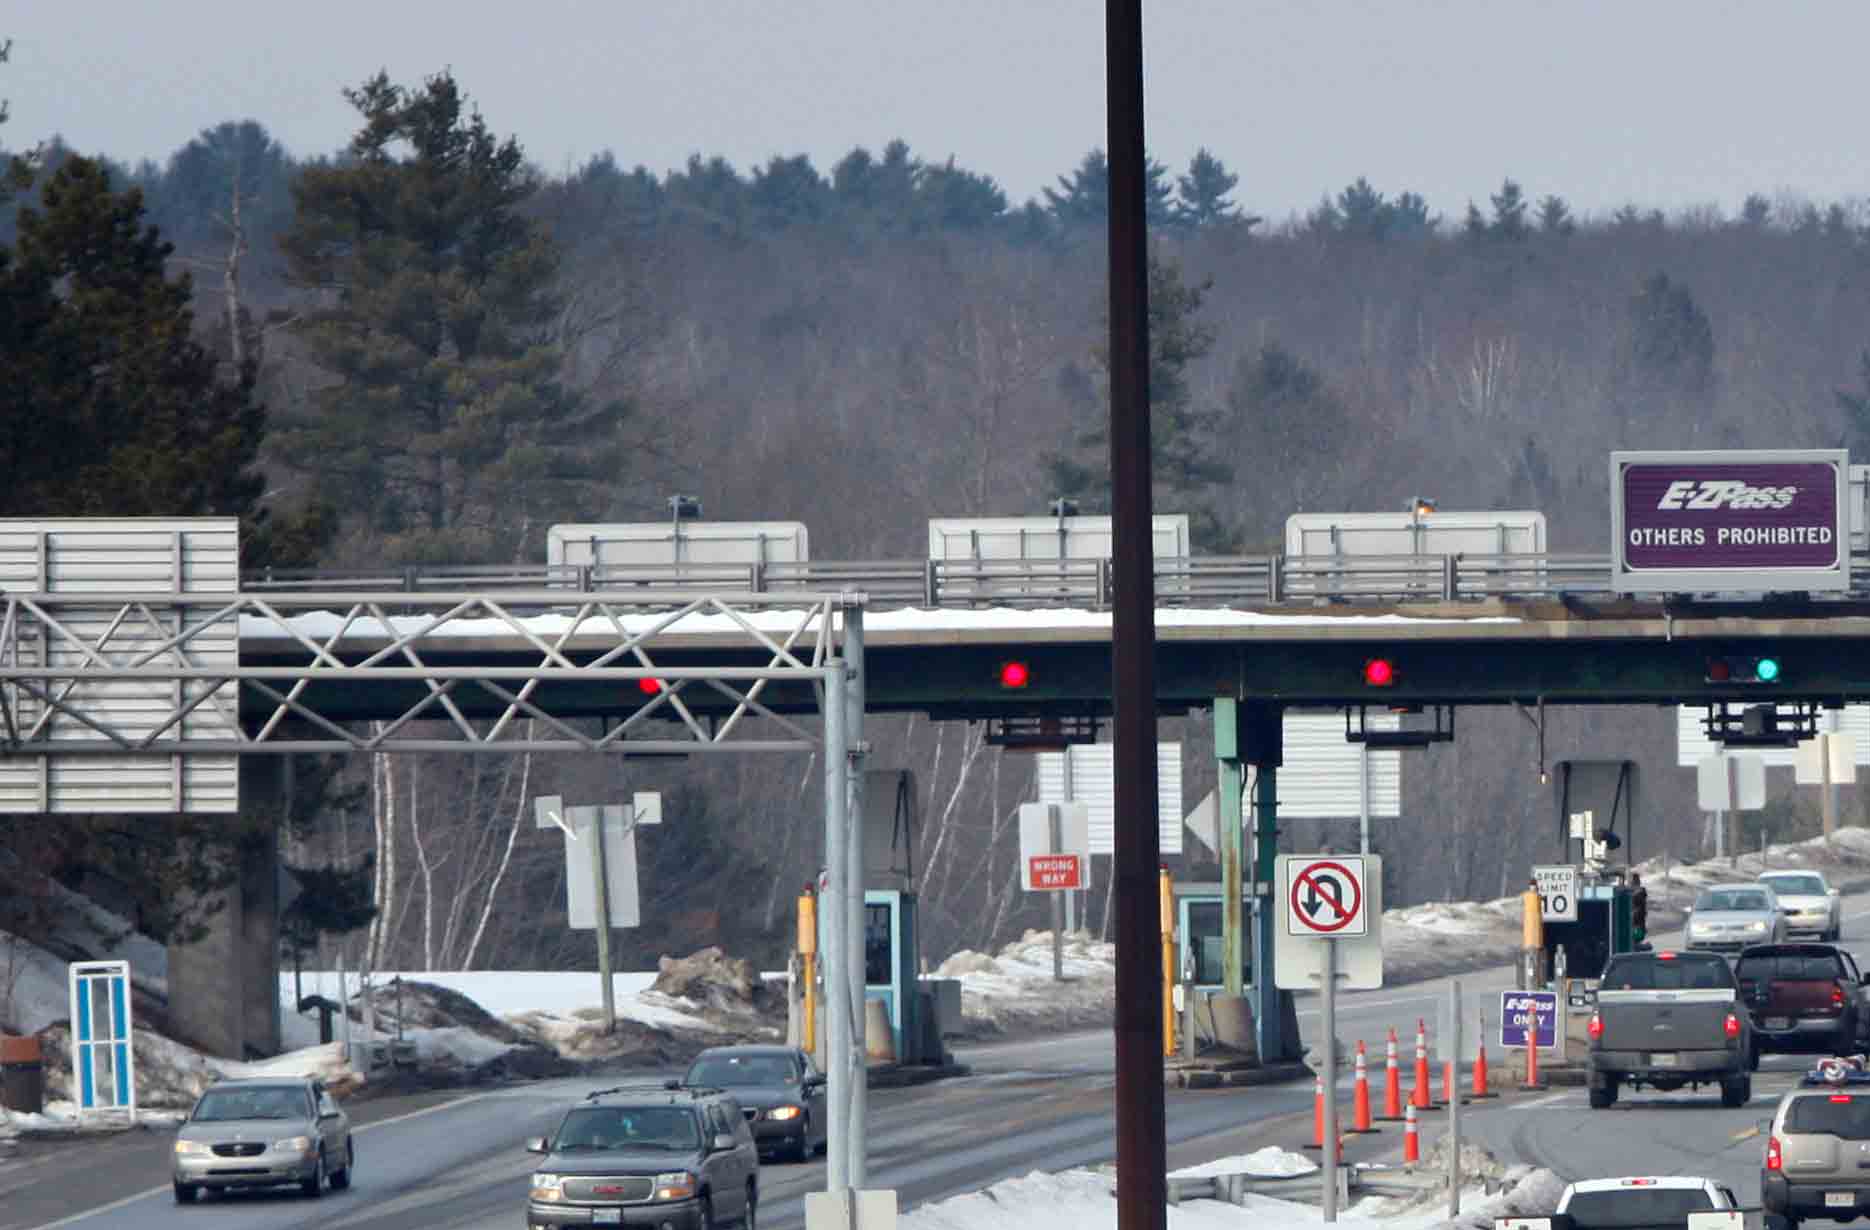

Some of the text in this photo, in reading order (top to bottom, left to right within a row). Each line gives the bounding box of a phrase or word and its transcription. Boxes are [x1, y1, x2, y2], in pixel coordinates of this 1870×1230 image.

[1630, 527, 1832, 545] OTHERS PROHIBITED
[1541, 895, 1567, 913] 10
[1513, 1014, 1544, 1024] ONY
